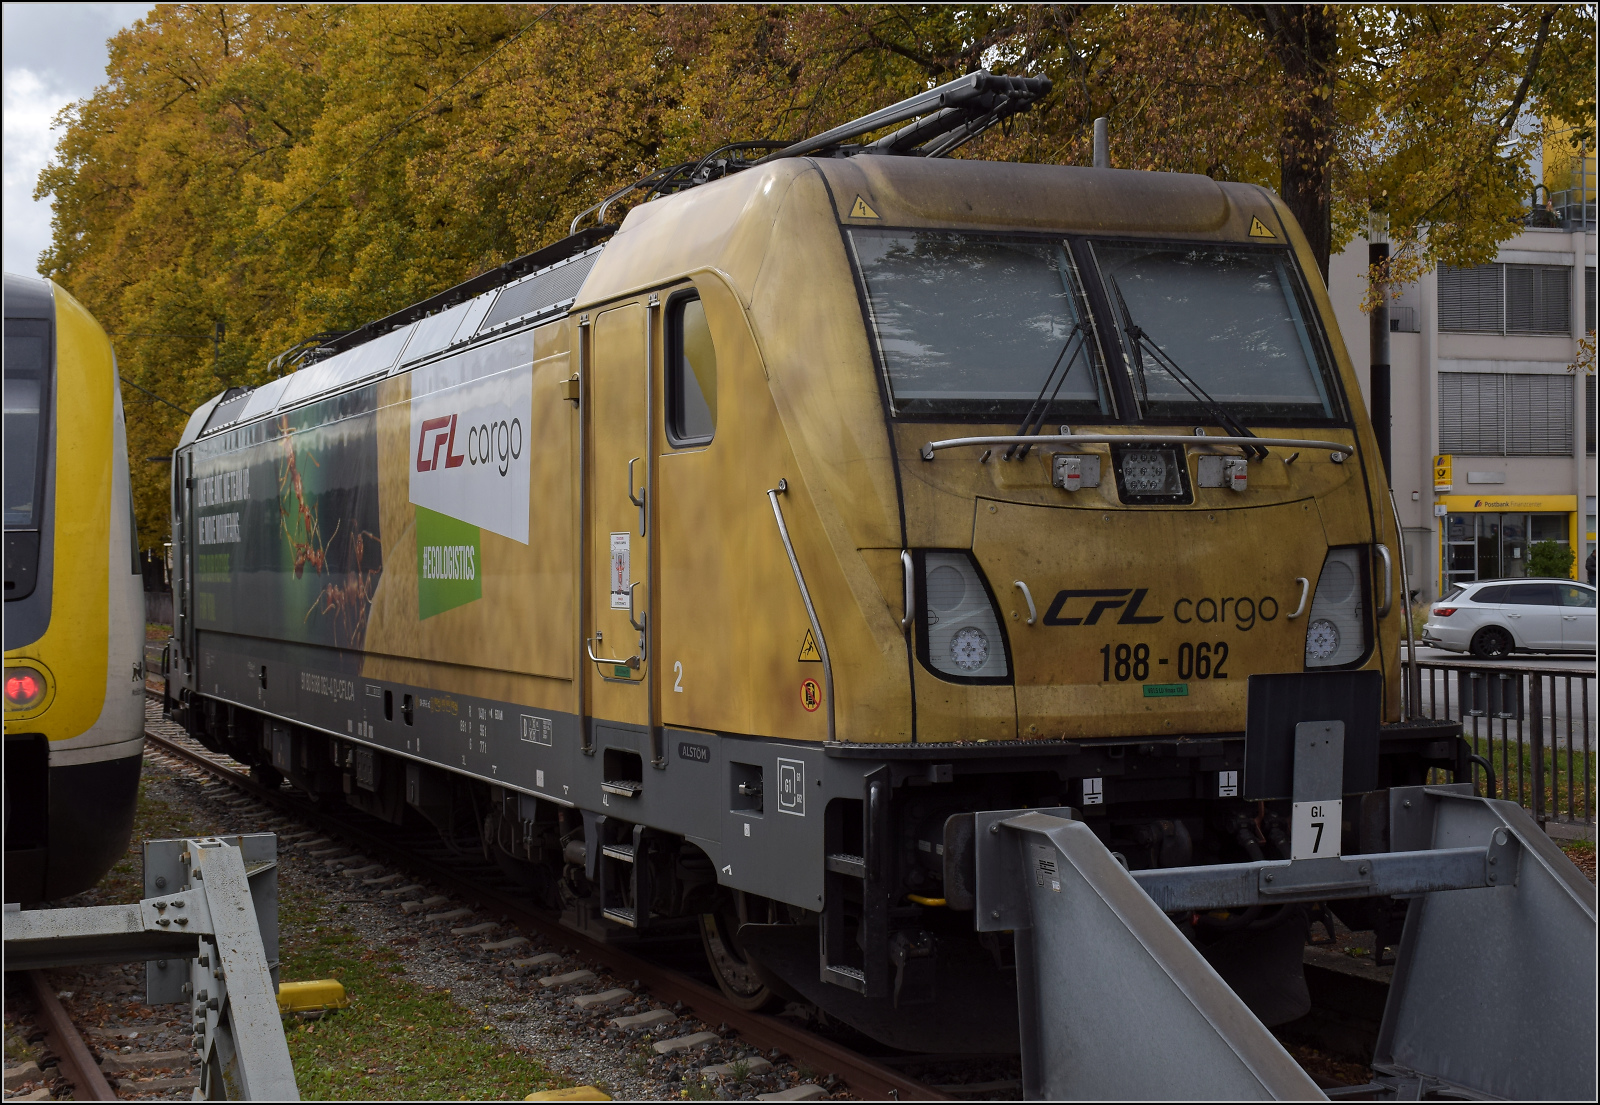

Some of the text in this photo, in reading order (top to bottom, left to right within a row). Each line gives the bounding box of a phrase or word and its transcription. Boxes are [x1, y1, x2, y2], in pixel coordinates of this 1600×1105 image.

[417, 413, 522, 477] CFL cargo
[423, 545, 475, 580] #ECOLOGISTICS
[1042, 588, 1279, 631] CFL cargo
[673, 660, 683, 693] 2
[1100, 643, 1150, 682] 188
[1177, 642, 1229, 680] 062
[682, 745, 707, 760] ALSTOM
[784, 778, 792, 794] G1
[1310, 823, 1324, 853] 7
